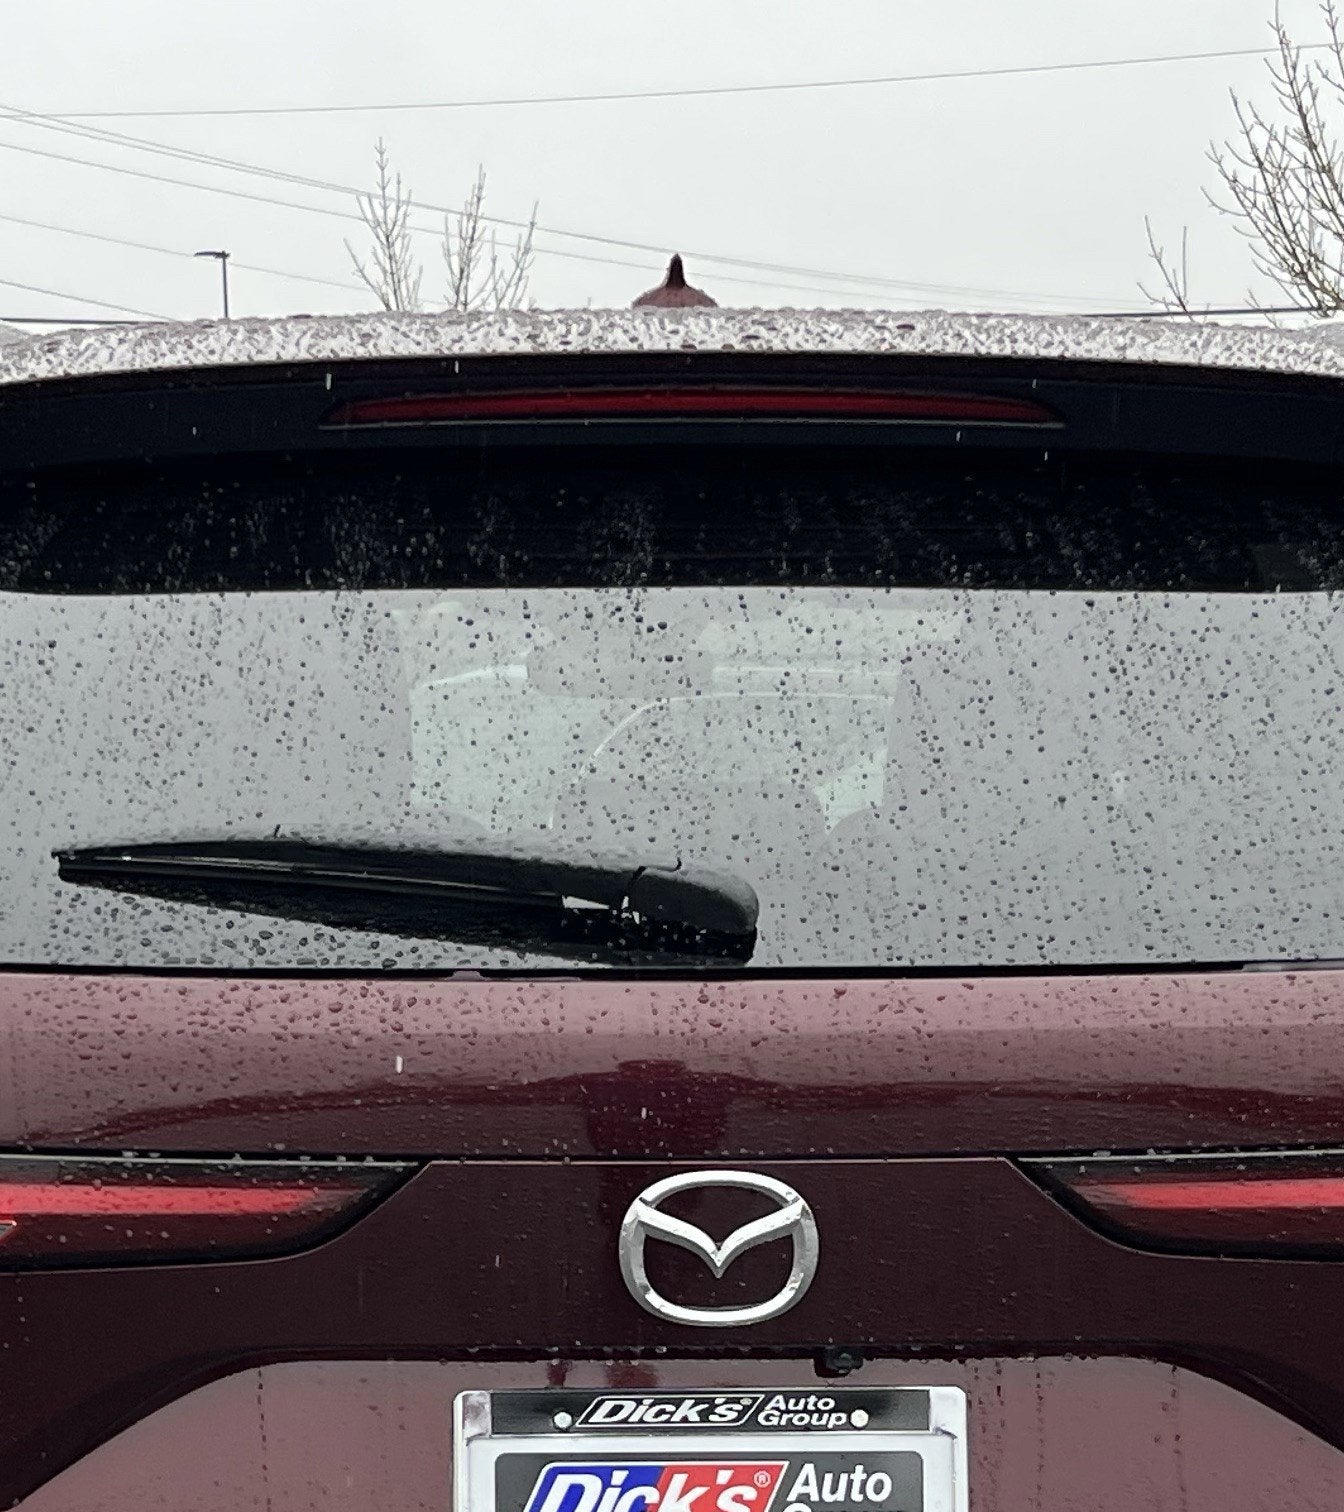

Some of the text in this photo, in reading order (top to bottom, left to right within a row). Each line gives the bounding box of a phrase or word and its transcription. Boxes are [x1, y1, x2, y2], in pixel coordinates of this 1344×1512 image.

[588, 1397, 743, 1423] Dick's
[764, 1394, 836, 1411] Auto
[757, 1409, 848, 1429] Group
[786, 1463, 893, 1503] Auto
